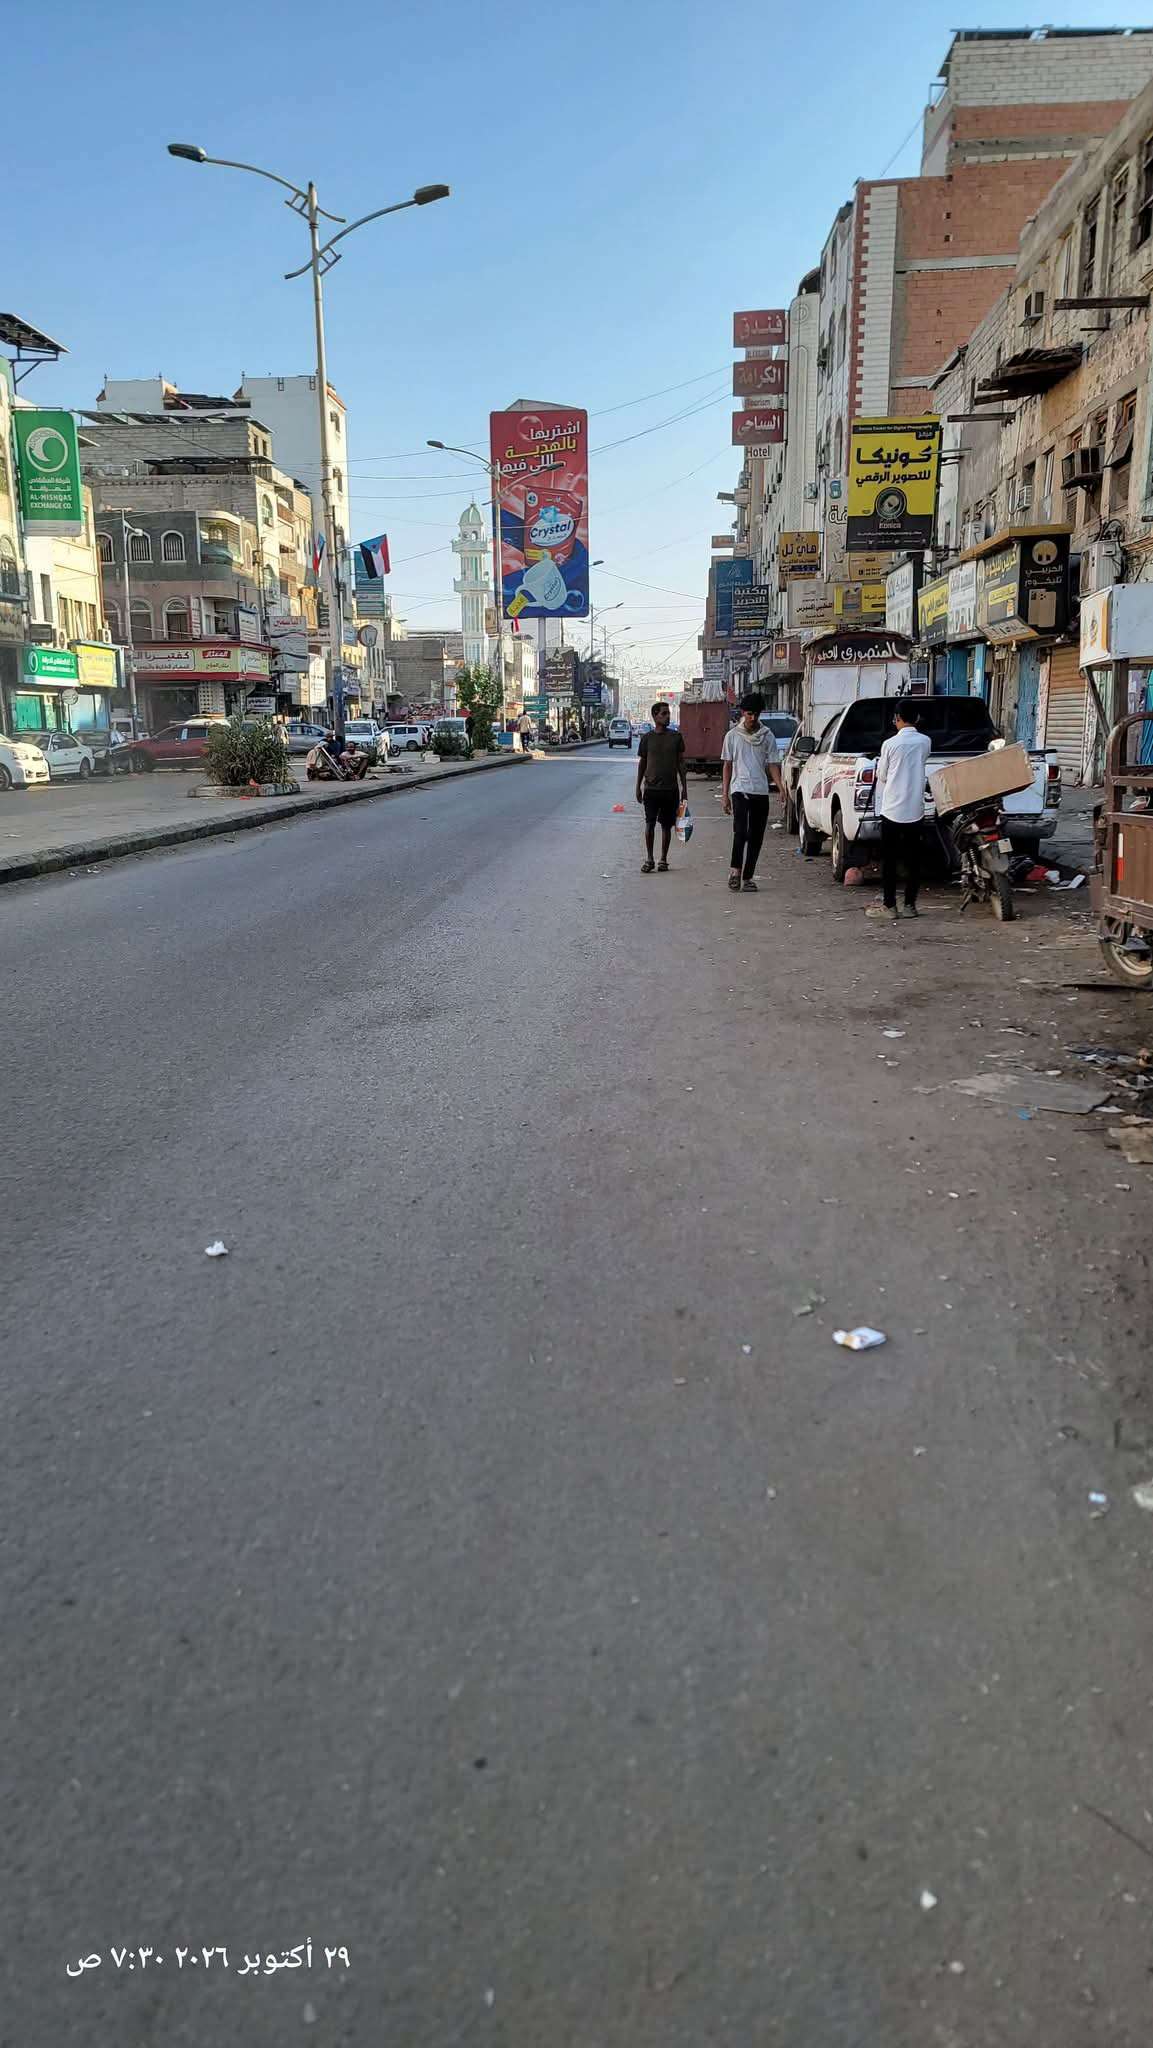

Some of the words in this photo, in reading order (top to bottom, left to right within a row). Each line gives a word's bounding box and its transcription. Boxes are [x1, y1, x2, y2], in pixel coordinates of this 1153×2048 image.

[740, 315, 783, 340] فندق
[738, 366, 781, 389] الكرامة
[530, 421, 580, 441] اشتريها
[505, 436, 577, 459] بالهدية
[747, 446, 770, 457] Hotel
[857, 445, 932, 468] كونيكا
[855, 472, 890, 487] الرقمي
[892, 470, 931, 484] للتصوير
[530, 520, 571, 539] Crystal
[782, 544, 794, 557] تل
[796, 543, 817, 557] هاي
[735, 586, 768, 599] مكتبة
